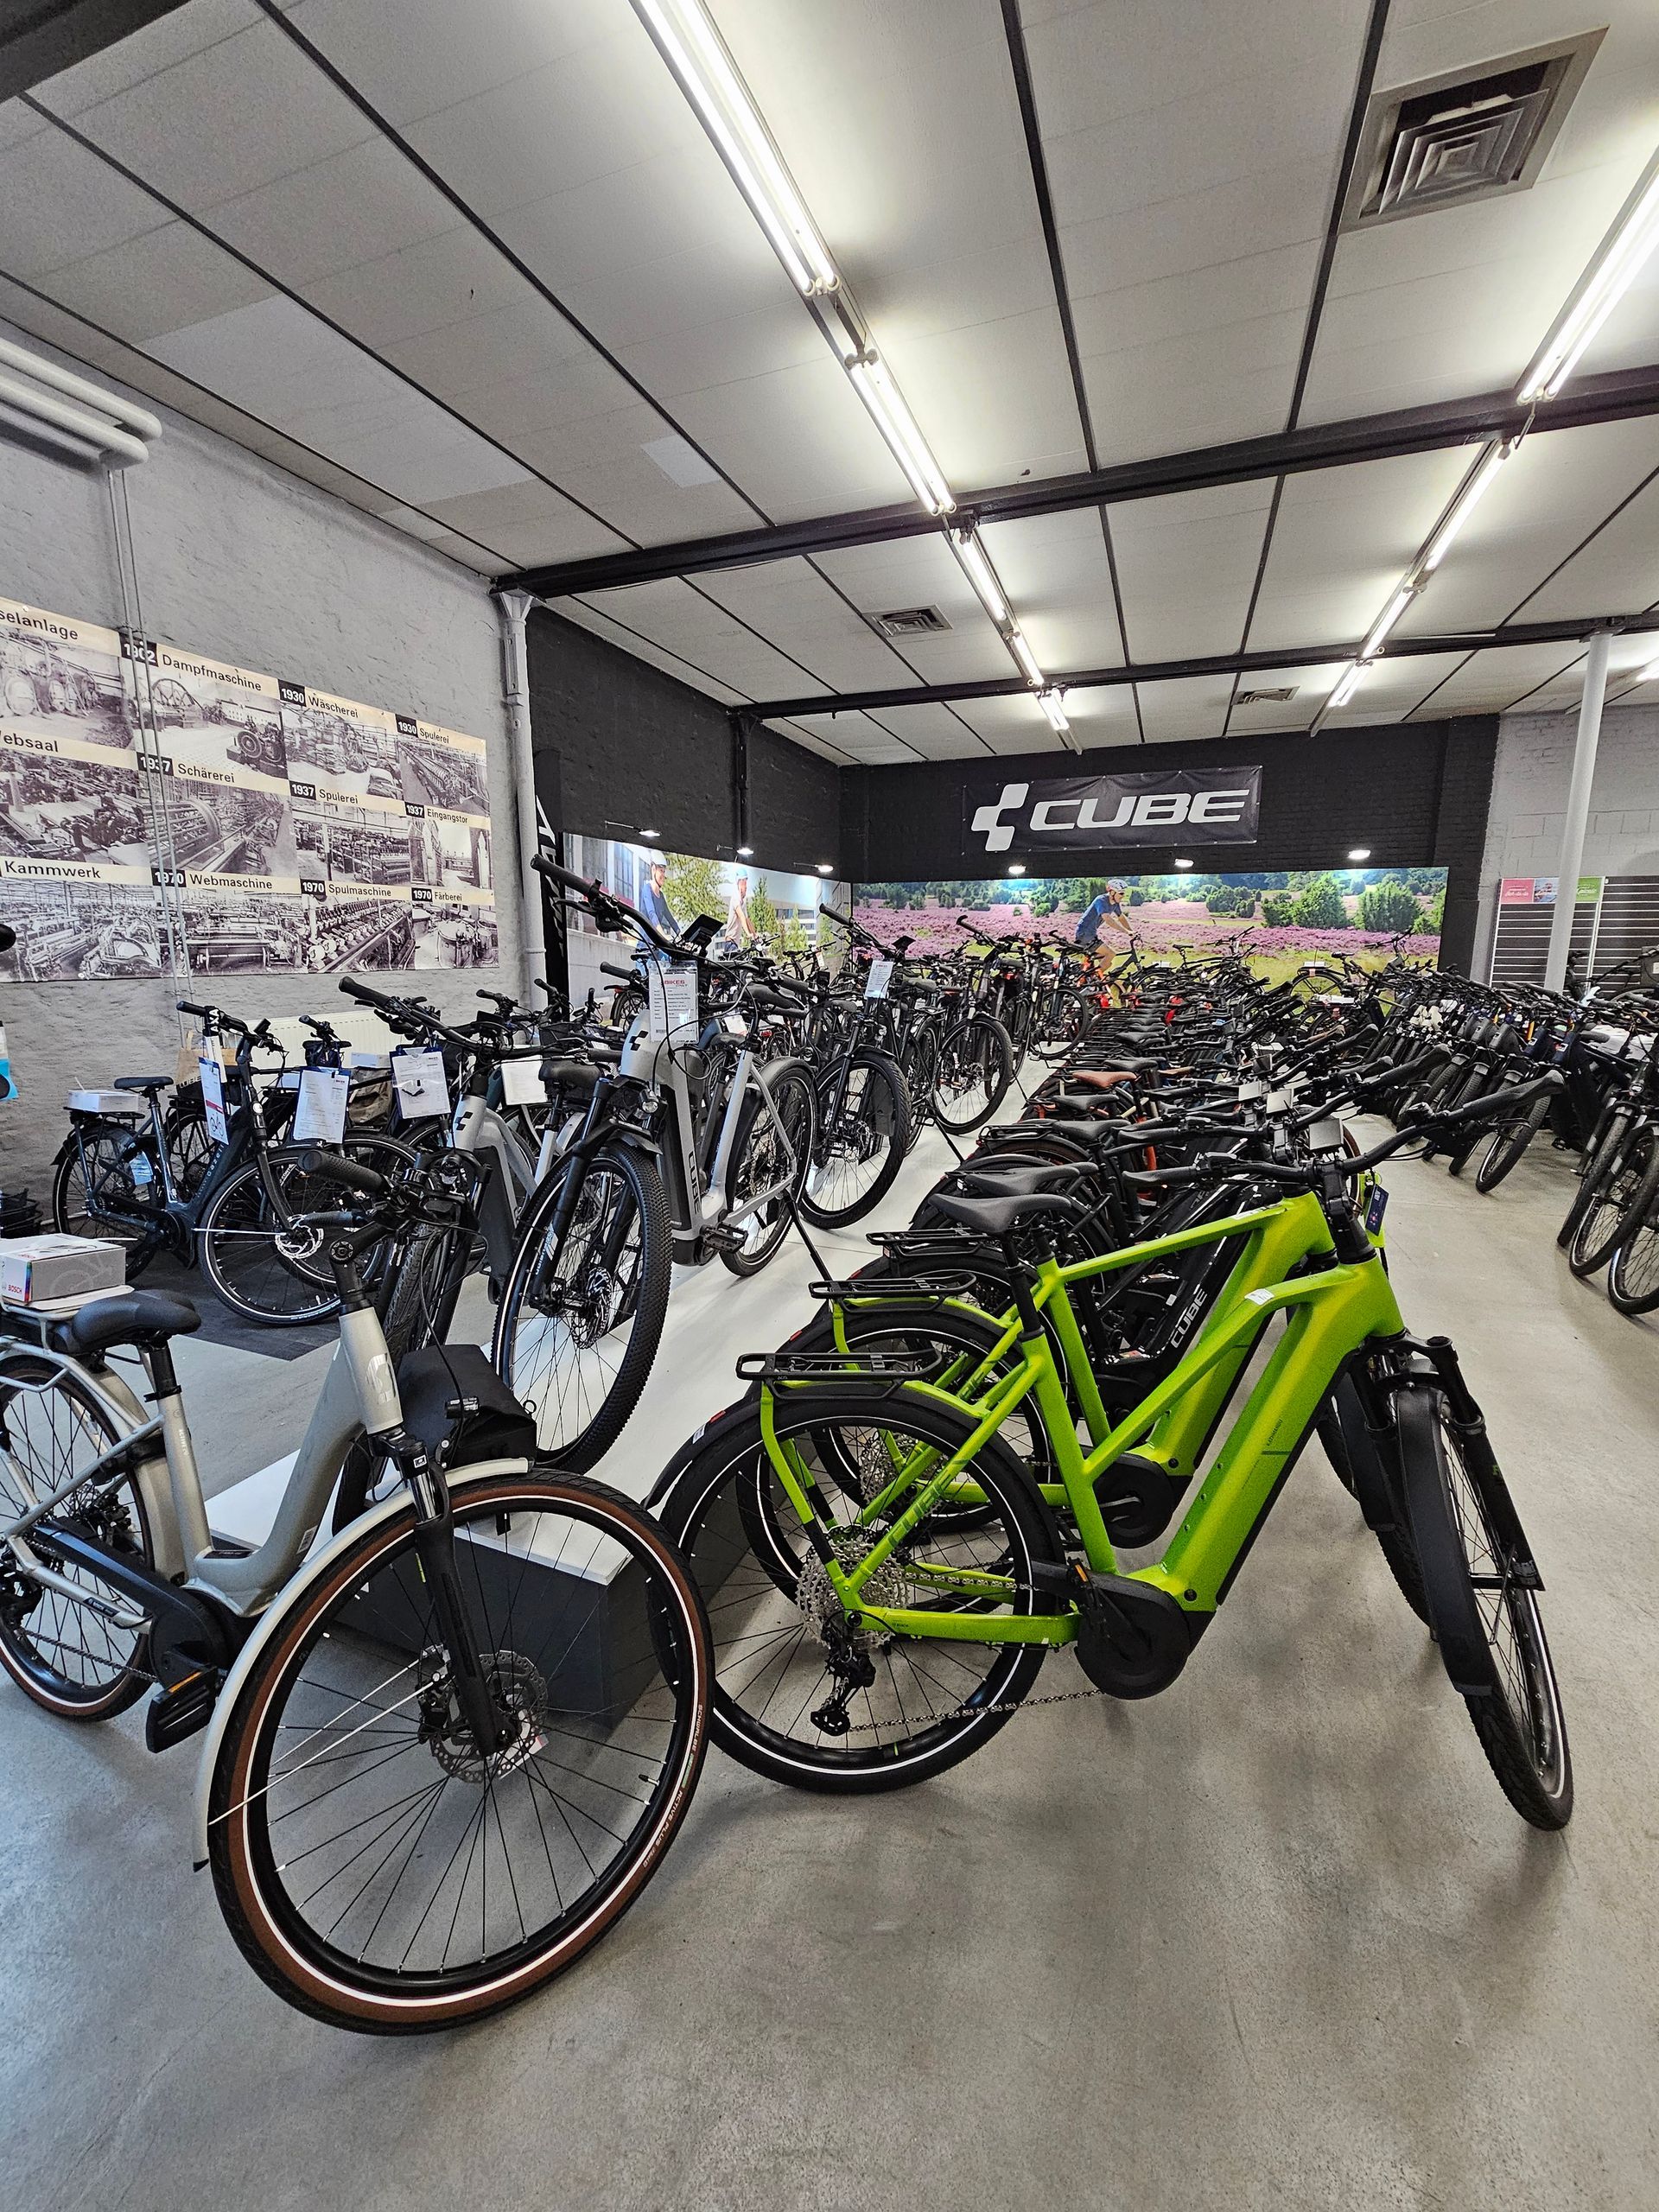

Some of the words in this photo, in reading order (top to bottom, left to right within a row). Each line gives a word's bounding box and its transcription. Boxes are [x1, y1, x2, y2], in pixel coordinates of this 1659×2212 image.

[162, 654, 263, 691] Dampfmaschine
[281, 688, 305, 704] 1930
[308, 695, 359, 719] Wäscherei
[0, 730, 59, 753] ebsaal
[397, 721, 417, 734] 1930
[419, 728, 449, 744] Spulerei
[177, 763, 235, 784] Schärerei
[291, 784, 315, 797] 1937
[319, 789, 359, 804] Spulerei
[406, 804, 423, 816] 1937
[427, 809, 468, 823] Eingangstor
[1029, 789, 1250, 831] CUBE
[4, 861, 101, 879] Kammwerk
[189, 874, 272, 889] Webmaschine
[302, 880, 324, 893] 1970
[328, 884, 391, 897] Spulmaschine
[413, 889, 432, 900] 1970
[435, 891, 462, 902] Färberei
[209, 1008, 219, 1033] AXA
[8, 1284, 22, 1294] BOSCH
[1171, 1288, 1208, 1348] CUBE
[691, 1704, 703, 1751] SCHWALBE
[667, 1789, 683, 1821] ACTIVE
[656, 1822, 671, 1847] PLUS
